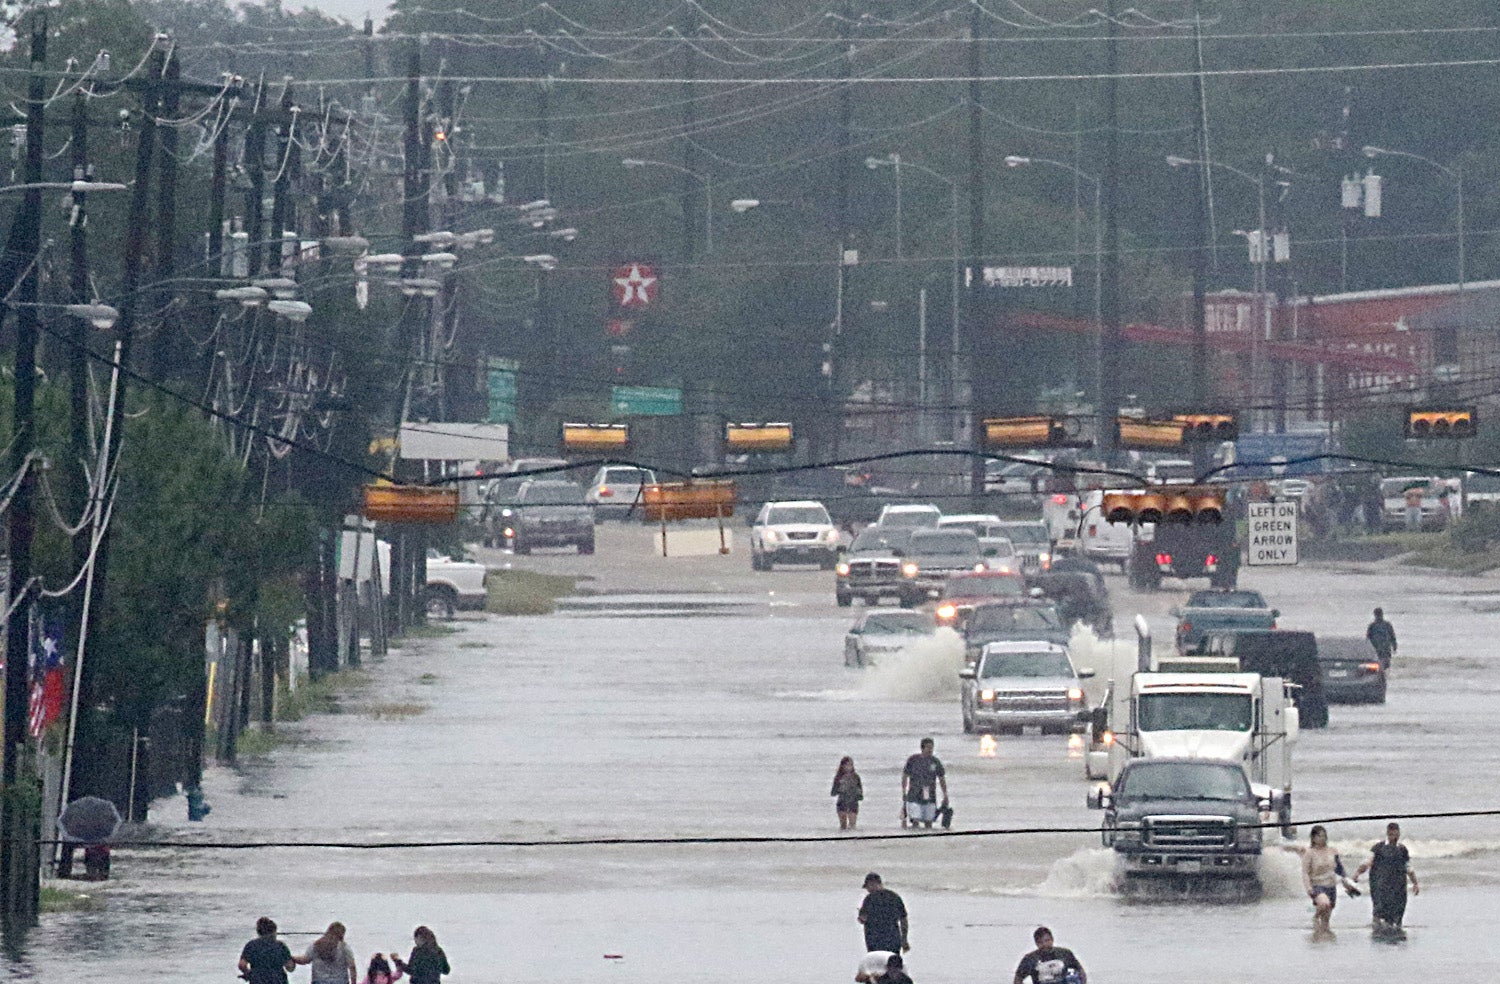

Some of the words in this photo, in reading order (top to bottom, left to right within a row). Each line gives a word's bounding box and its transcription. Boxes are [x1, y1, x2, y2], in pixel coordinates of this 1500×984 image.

[1250, 507, 1276, 517] LEFT
[1279, 506, 1294, 517] ON
[1254, 521, 1291, 531] GREEN
[1253, 535, 1293, 546] ARROW
[1257, 550, 1287, 560] ONLY
